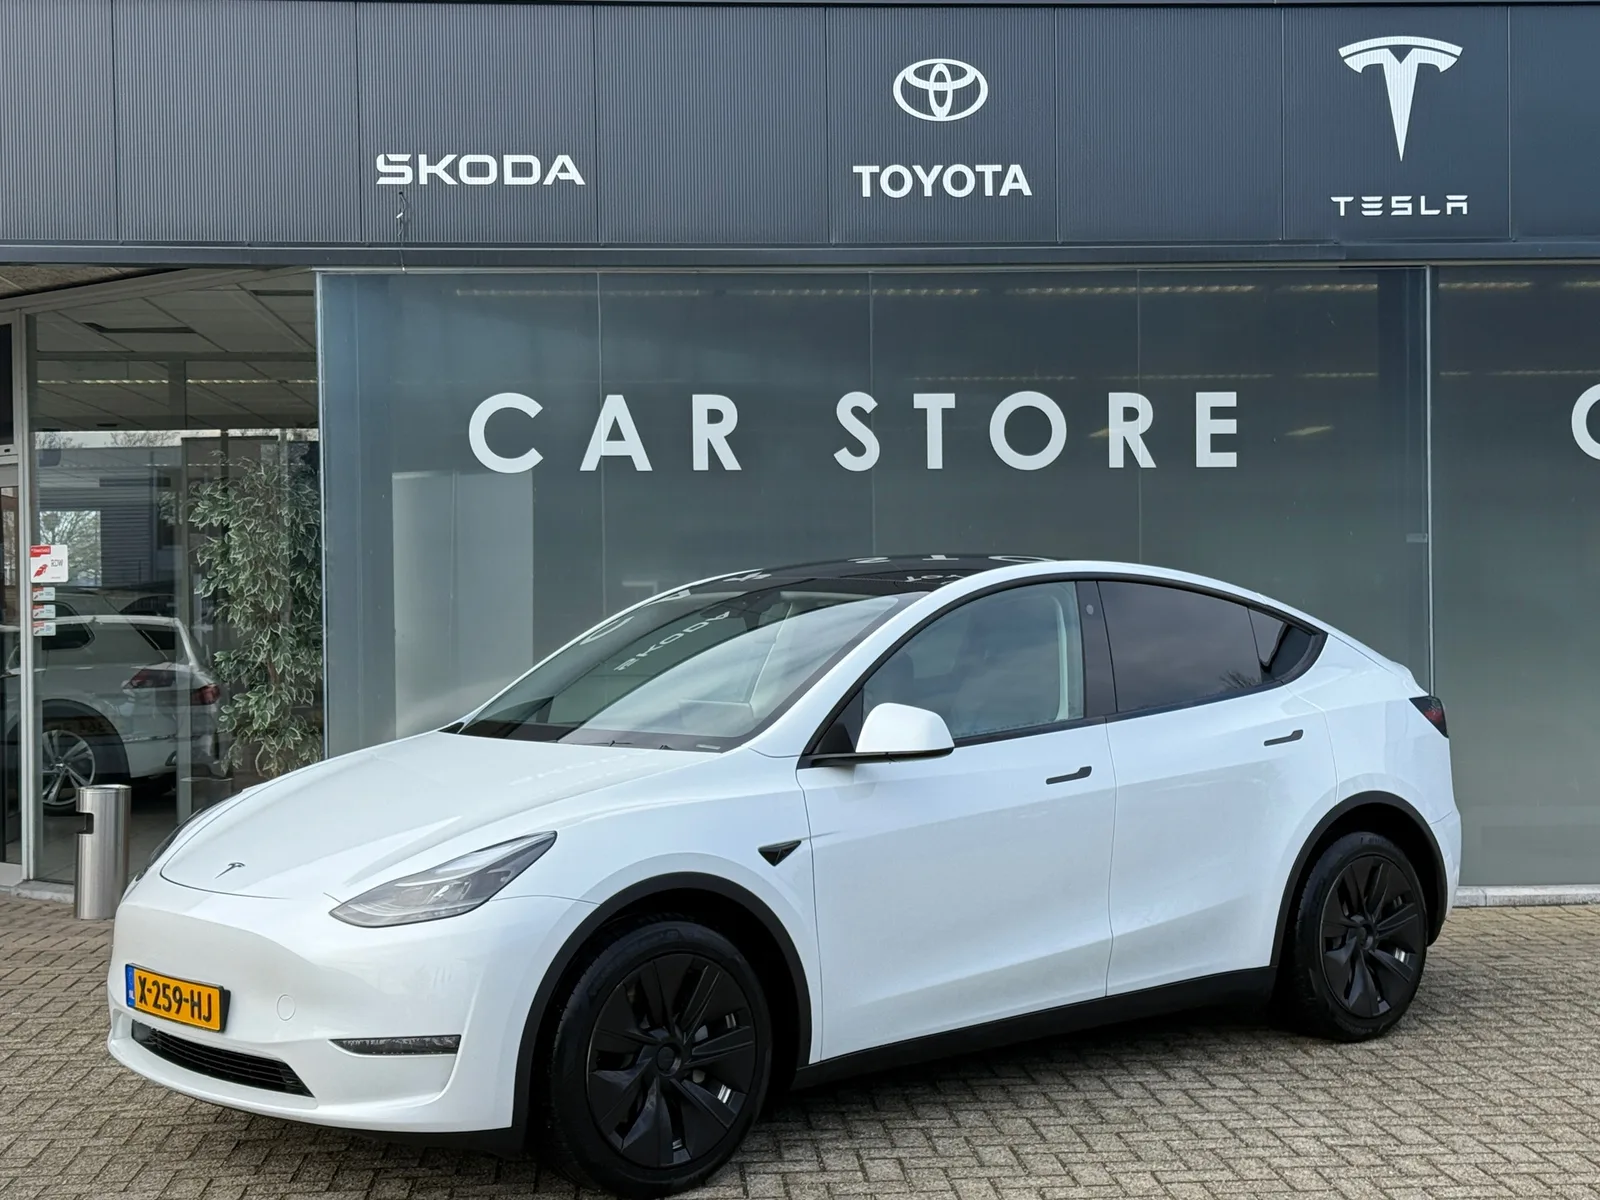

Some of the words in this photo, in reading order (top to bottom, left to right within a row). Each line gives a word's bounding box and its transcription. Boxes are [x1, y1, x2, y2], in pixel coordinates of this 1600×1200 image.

[376, 154, 585, 186] SKODA
[853, 164, 1032, 198] TOYOTA
[1331, 195, 1468, 217] TESLA
[468, 392, 742, 474] CAR
[834, 390, 1238, 472] STORE
[138, 976, 212, 1023] X-259-HJ
